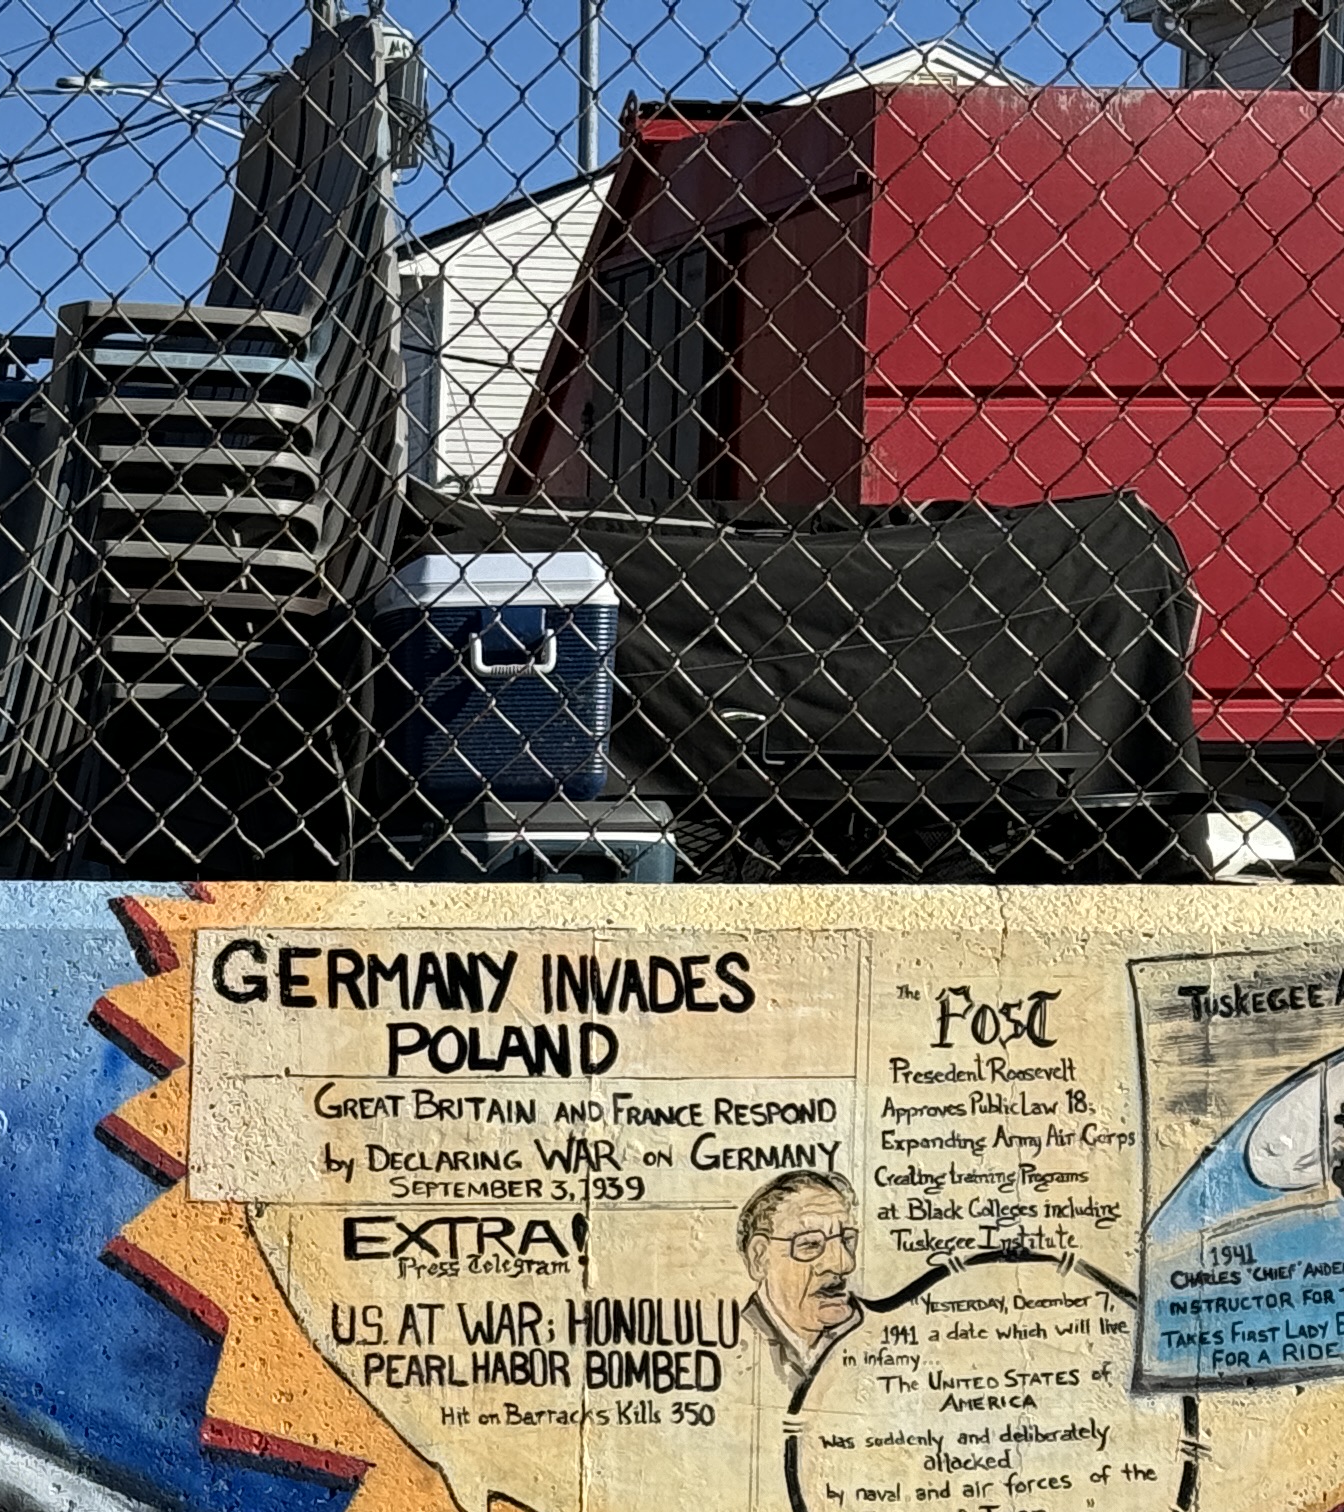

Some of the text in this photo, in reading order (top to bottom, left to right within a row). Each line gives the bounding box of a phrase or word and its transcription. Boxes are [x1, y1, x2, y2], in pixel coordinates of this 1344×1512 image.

[212, 940, 754, 1015] GERMANY INVADES
[897, 984, 920, 1000] The
[386, 1023, 618, 1077] POLAND
[986, 1056, 1076, 1083] Roosevelt
[314, 1083, 837, 1127] GREAT BRITAIN AND FRANCE RESPOND
[881, 1097, 967, 1126] Approves
[882, 1123, 1136, 1157] Expanding Army Air Corps
[325, 1144, 353, 1181] by
[367, 1143, 523, 1172] DECLARING
[536, 1131, 621, 1174] WAR
[690, 1134, 841, 1172] GERMANY
[389, 1176, 542, 1198] SEPTEMBER
[1017, 1164, 1089, 1193] Programs
[877, 1196, 1122, 1229] at Black Colleges including
[343, 1213, 588, 1266] EXTRA!
[890, 1229, 976, 1267] Tuskegee
[397, 1254, 571, 1280] Press Telegram
[1211, 1243, 1257, 1266] 1941
[1170, 1270, 1242, 1289] CHARLES
[1013, 1292, 1092, 1309] December
[1170, 1289, 1335, 1316] INSTRUCTOR FOR
[398, 1303, 444, 1346] AT
[567, 1298, 739, 1348] HONOLULU
[880, 1317, 1130, 1346] 1941 a date which will live
[1161, 1329, 1224, 1348] TAKES
[1231, 1320, 1280, 1344] FIRST
[1285, 1319, 1328, 1339] LADY
[365, 1348, 721, 1392] PEARL HABOR BOMBED
[843, 1349, 857, 1367] in
[1213, 1342, 1340, 1369] FOR A RIDE
[877, 1362, 1112, 1394] The UNITED STATES of
[442, 1401, 715, 1427] Hit on Barracks Kills 350
[939, 1394, 1037, 1413] AMERICA
[820, 1418, 1110, 1451] was suddenly and deliberately
[923, 1450, 1011, 1474] attacked
[826, 1464, 1158, 1505] by naval and air forces of the
